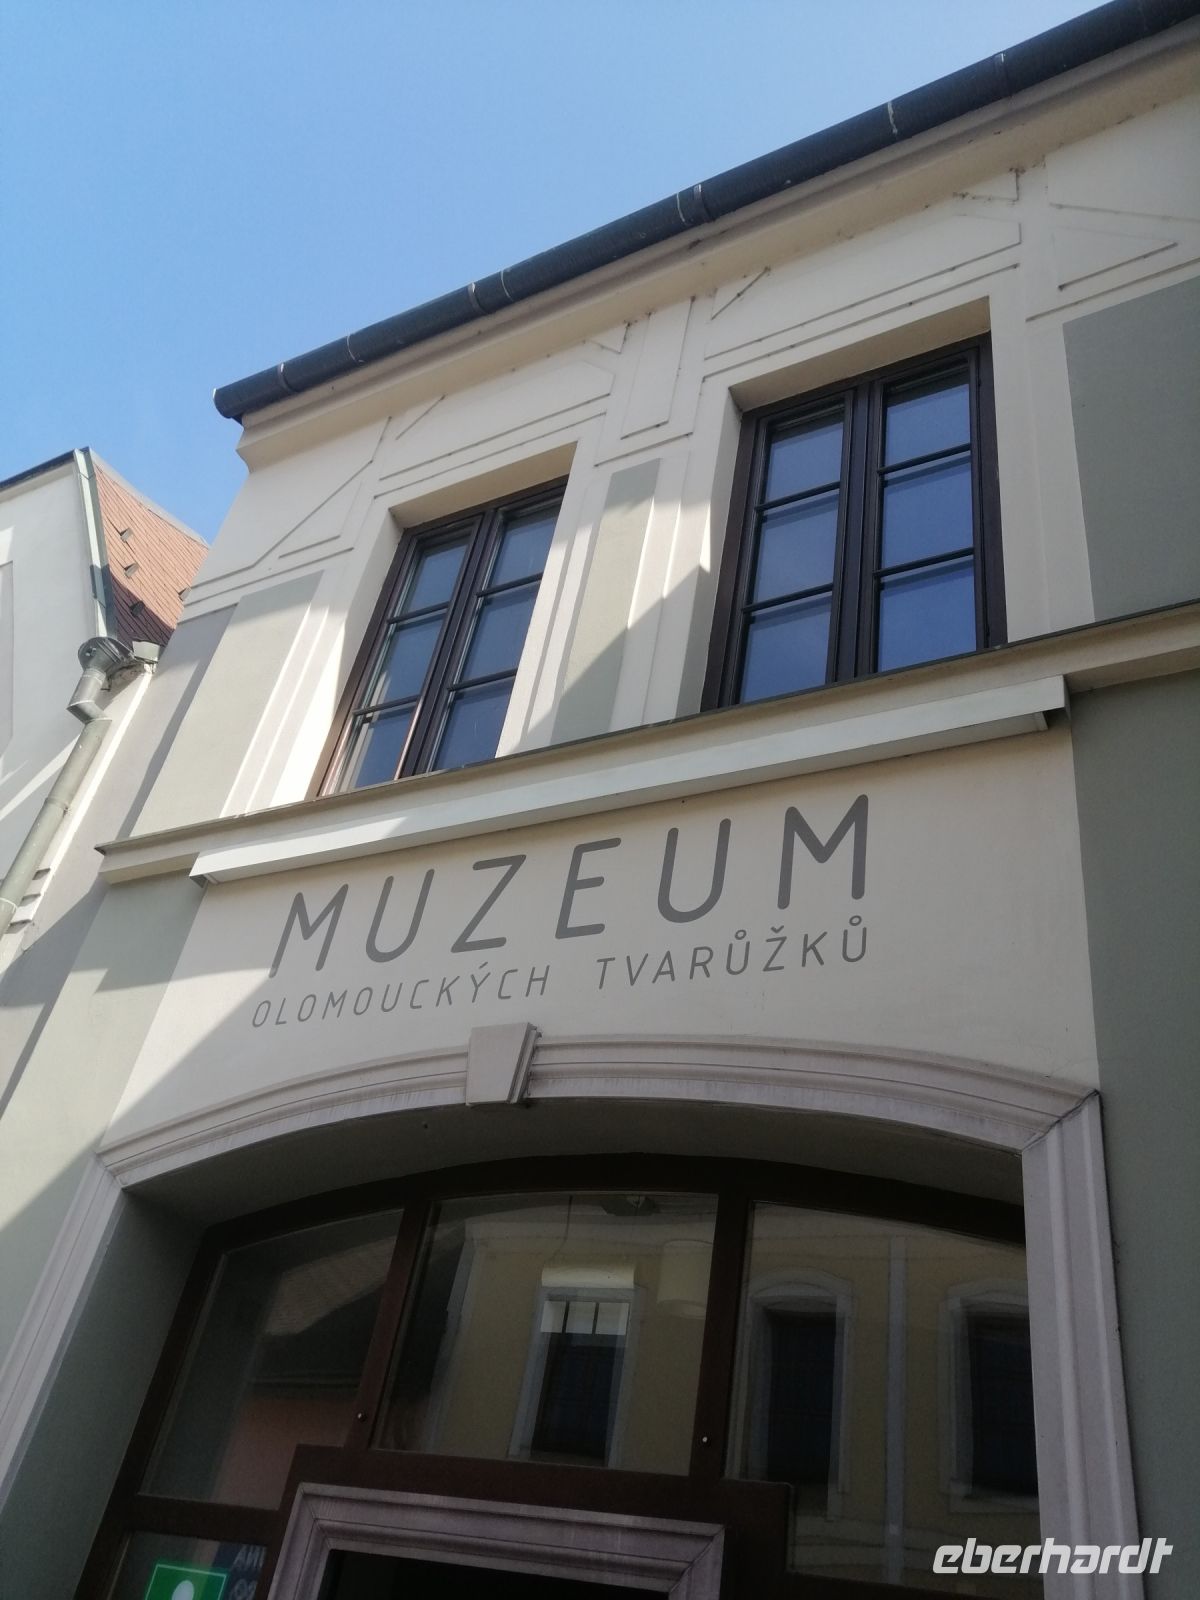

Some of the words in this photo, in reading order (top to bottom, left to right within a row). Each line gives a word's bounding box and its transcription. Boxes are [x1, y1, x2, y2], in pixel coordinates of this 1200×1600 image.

[269, 794, 869, 978] MUZEUM
[252, 962, 550, 1028] OLOMOUCKÝCH
[596, 915, 868, 990] TVARŮŽKŮ
